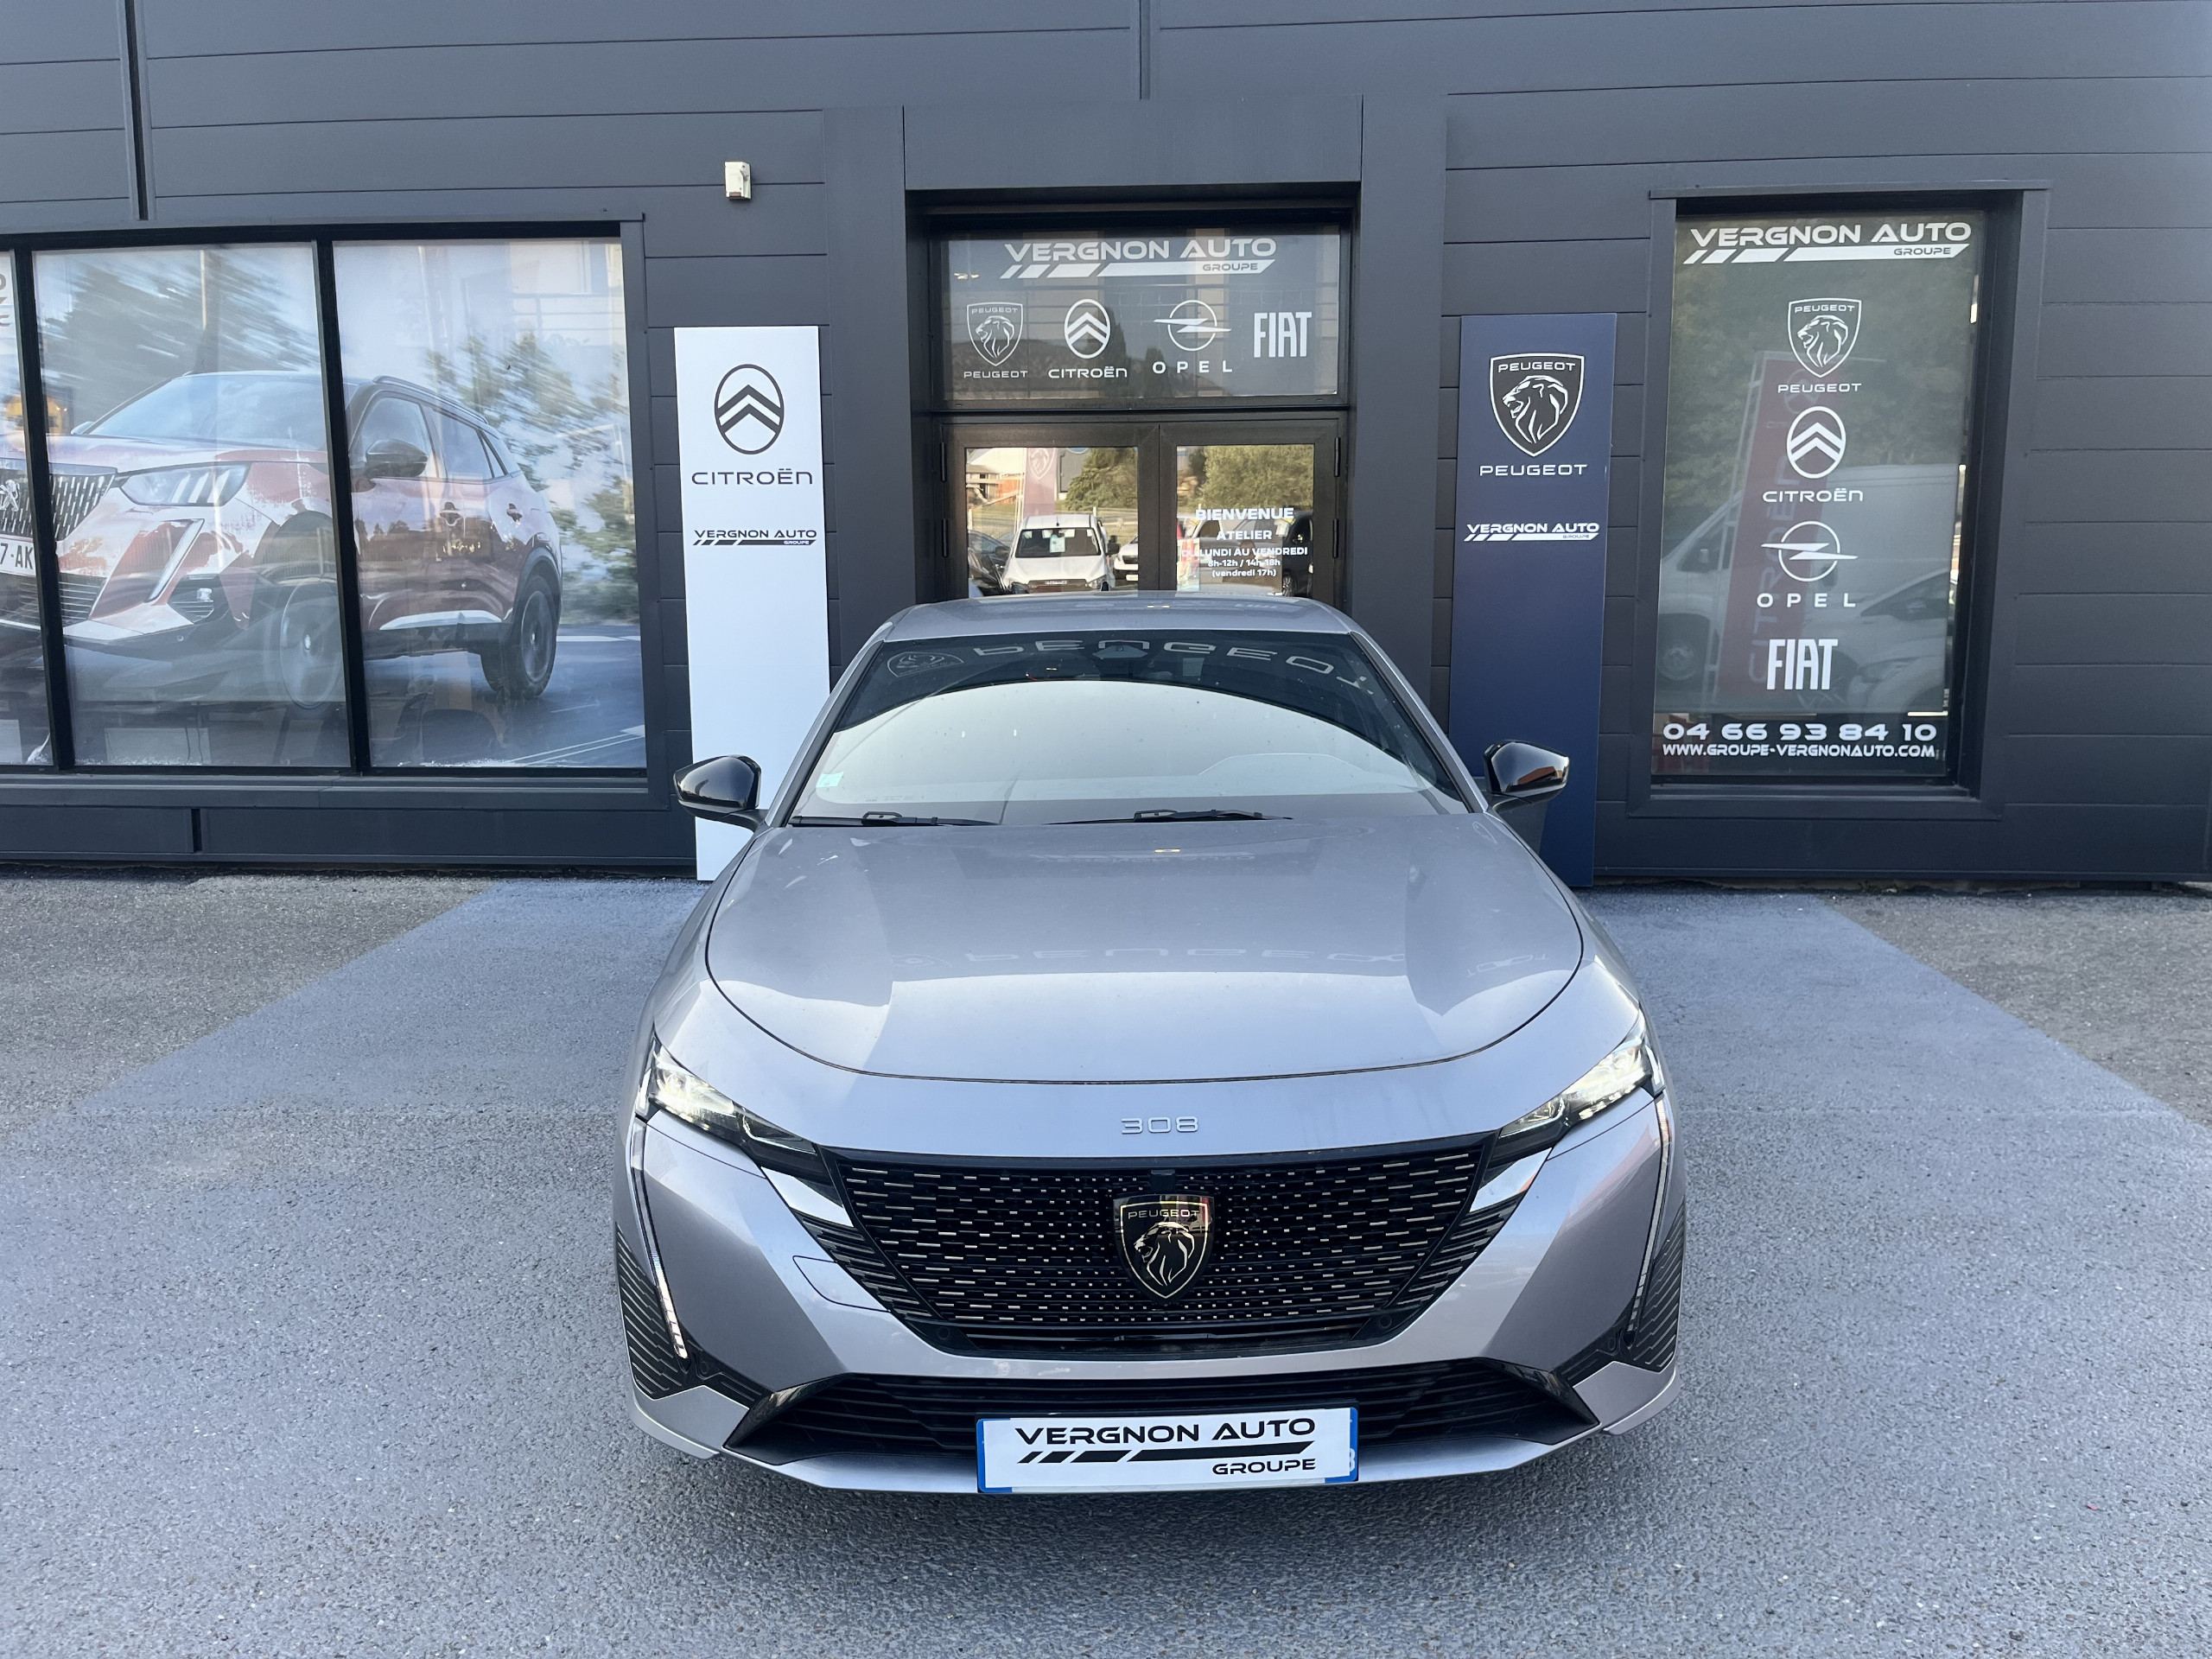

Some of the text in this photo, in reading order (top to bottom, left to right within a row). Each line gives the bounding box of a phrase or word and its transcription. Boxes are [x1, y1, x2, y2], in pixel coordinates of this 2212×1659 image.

[1690, 222, 1971, 247] VERGNON AUTO
[1004, 238, 1277, 262] VERGNON AUTO
[1893, 246, 1951, 256] GROUPE
[1202, 262, 1258, 272] GROUPE
[971, 307, 1018, 315] PEUGEOT
[1795, 304, 1855, 314] PEUGEOT
[1254, 312, 1313, 358] FIAT
[1153, 360, 1233, 374] OPEL
[1498, 361, 1576, 373] PEUGEOT
[963, 370, 1028, 378] PEUGEOT
[1777, 383, 1862, 393] PEUGEOT
[1479, 464, 1588, 476] PEUGEOT
[1195, 507, 1294, 521] BIENVENUE
[694, 530, 817, 538] VERGNON AUTO
[1467, 523, 1599, 534] VERGNON AUTO
[1216, 530, 1272, 541] ATELIER
[1199, 548, 1231, 557] LUNDI
[1234, 548, 1249, 556] AU
[1252, 547, 1308, 556] VENDREDI
[1208, 559, 1238, 568] 8h-12h
[1211, 569, 1277, 578] (vendredi 17h)
[1757, 593, 1857, 608] OPEL
[1766, 639, 1839, 690] FIAT
[1662, 722, 1937, 741] 04 66 93 84 10
[1662, 743, 1936, 758] WWW.GROUPE-VERGNONAUTO.COM
[1122, 1116, 1198, 1134] 308
[1128, 1209, 1200, 1219] PEUGEOT
[1015, 1418, 1315, 1445] VERGNON AUTO
[1212, 1458, 1316, 1475] GROUPE
